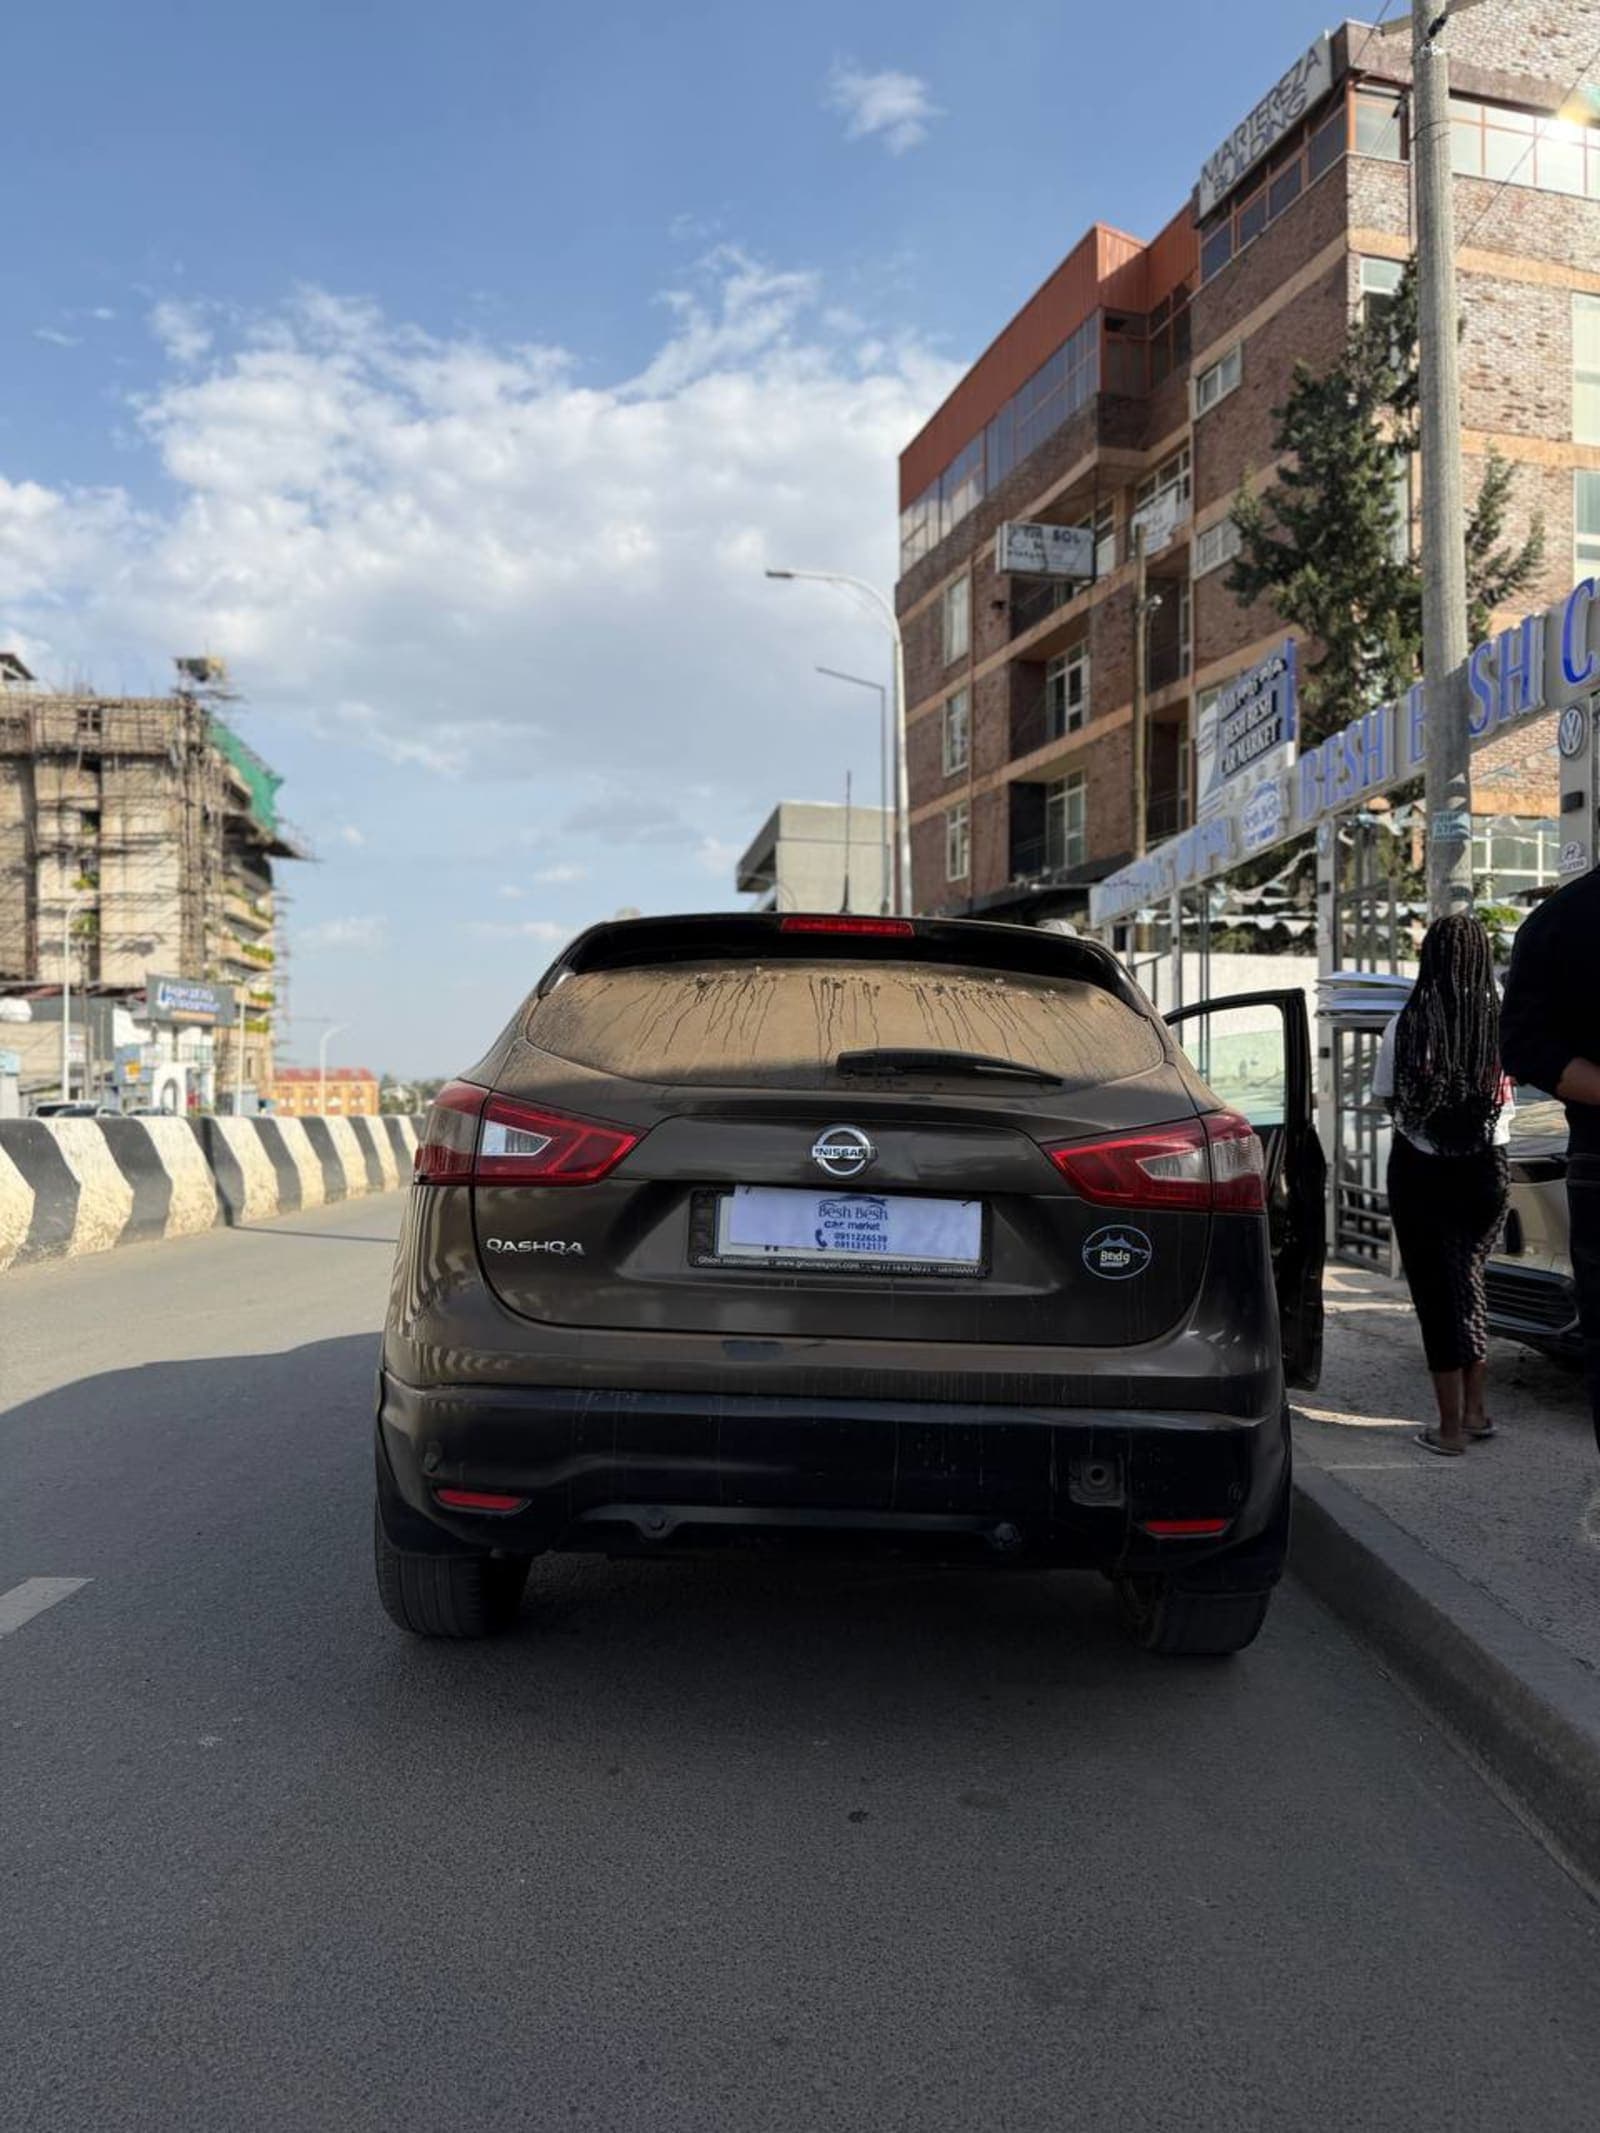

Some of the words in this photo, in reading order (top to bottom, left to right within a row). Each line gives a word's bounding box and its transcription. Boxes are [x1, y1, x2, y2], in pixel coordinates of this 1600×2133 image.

[1299, 703, 1388, 824] BESH
[819, 1148, 866, 1157] NISSAN
[818, 1203, 852, 1219] Besh
[855, 1205, 888, 1221] Besh
[847, 1221, 880, 1231] market
